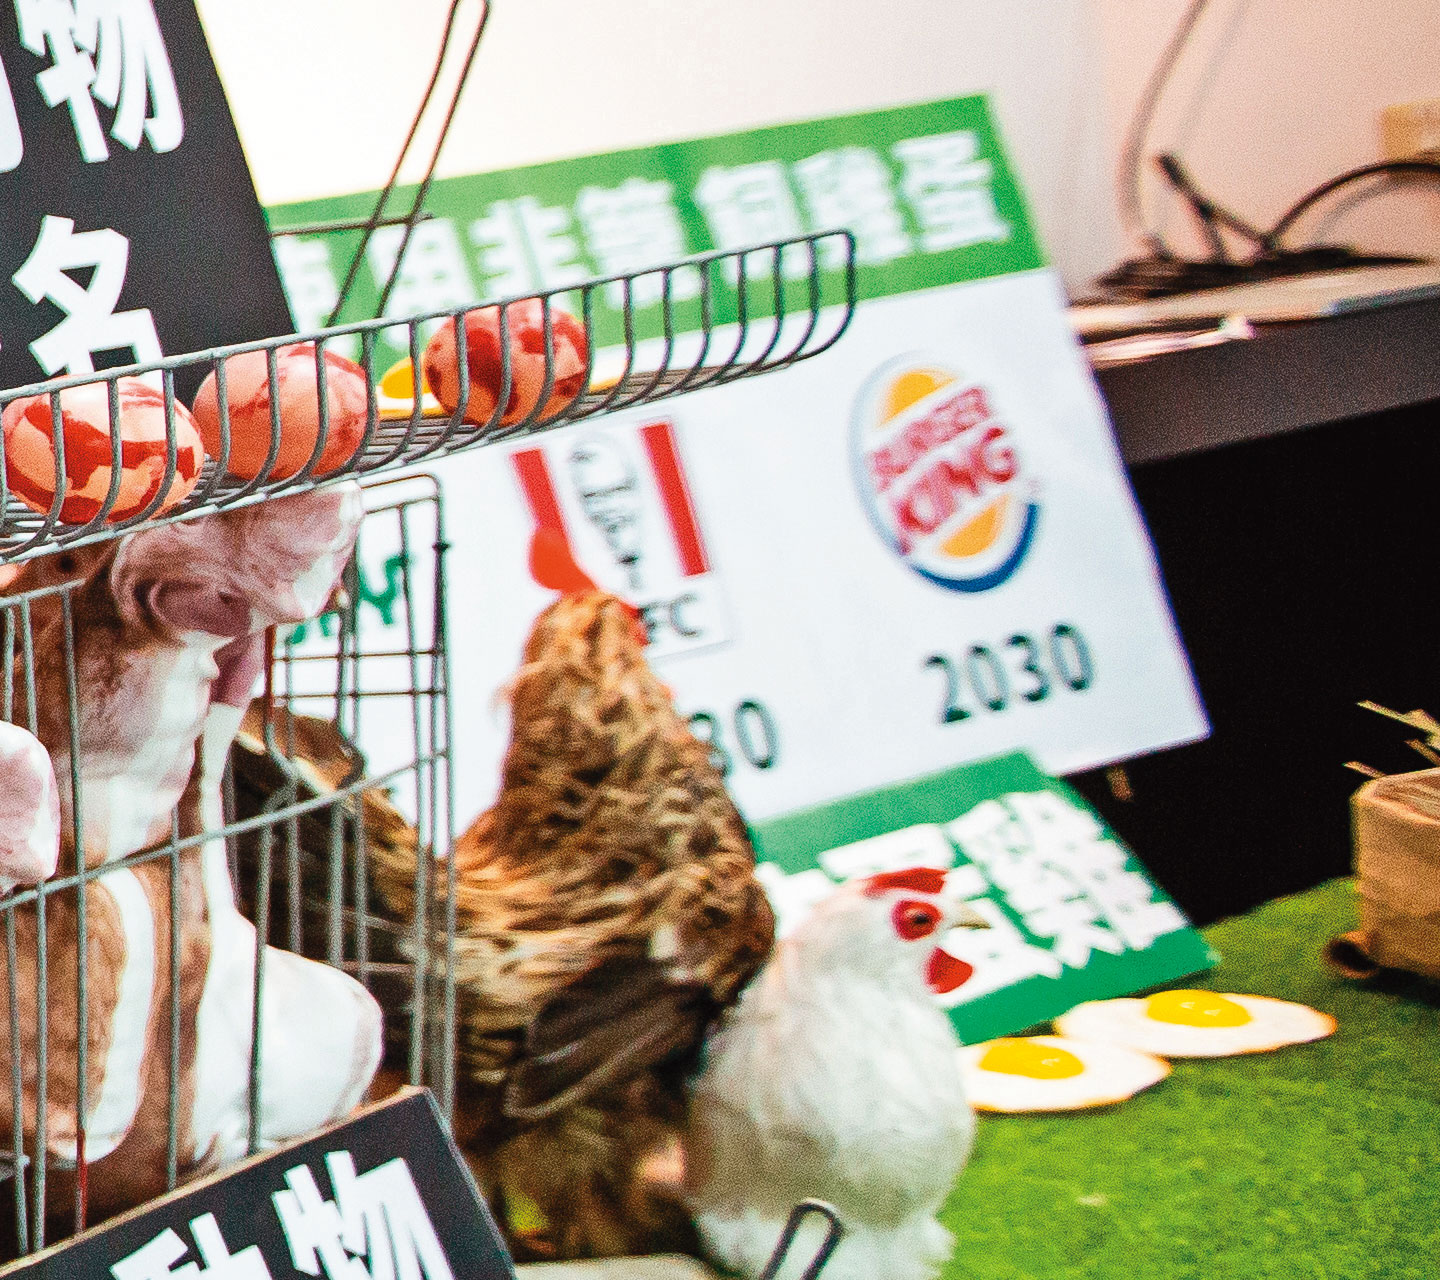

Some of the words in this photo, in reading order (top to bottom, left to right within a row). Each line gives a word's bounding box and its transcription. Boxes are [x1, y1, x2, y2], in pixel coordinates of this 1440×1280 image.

[868, 386, 993, 494] BURGER
[891, 423, 1020, 557] KING
[923, 621, 1097, 726] 2030
